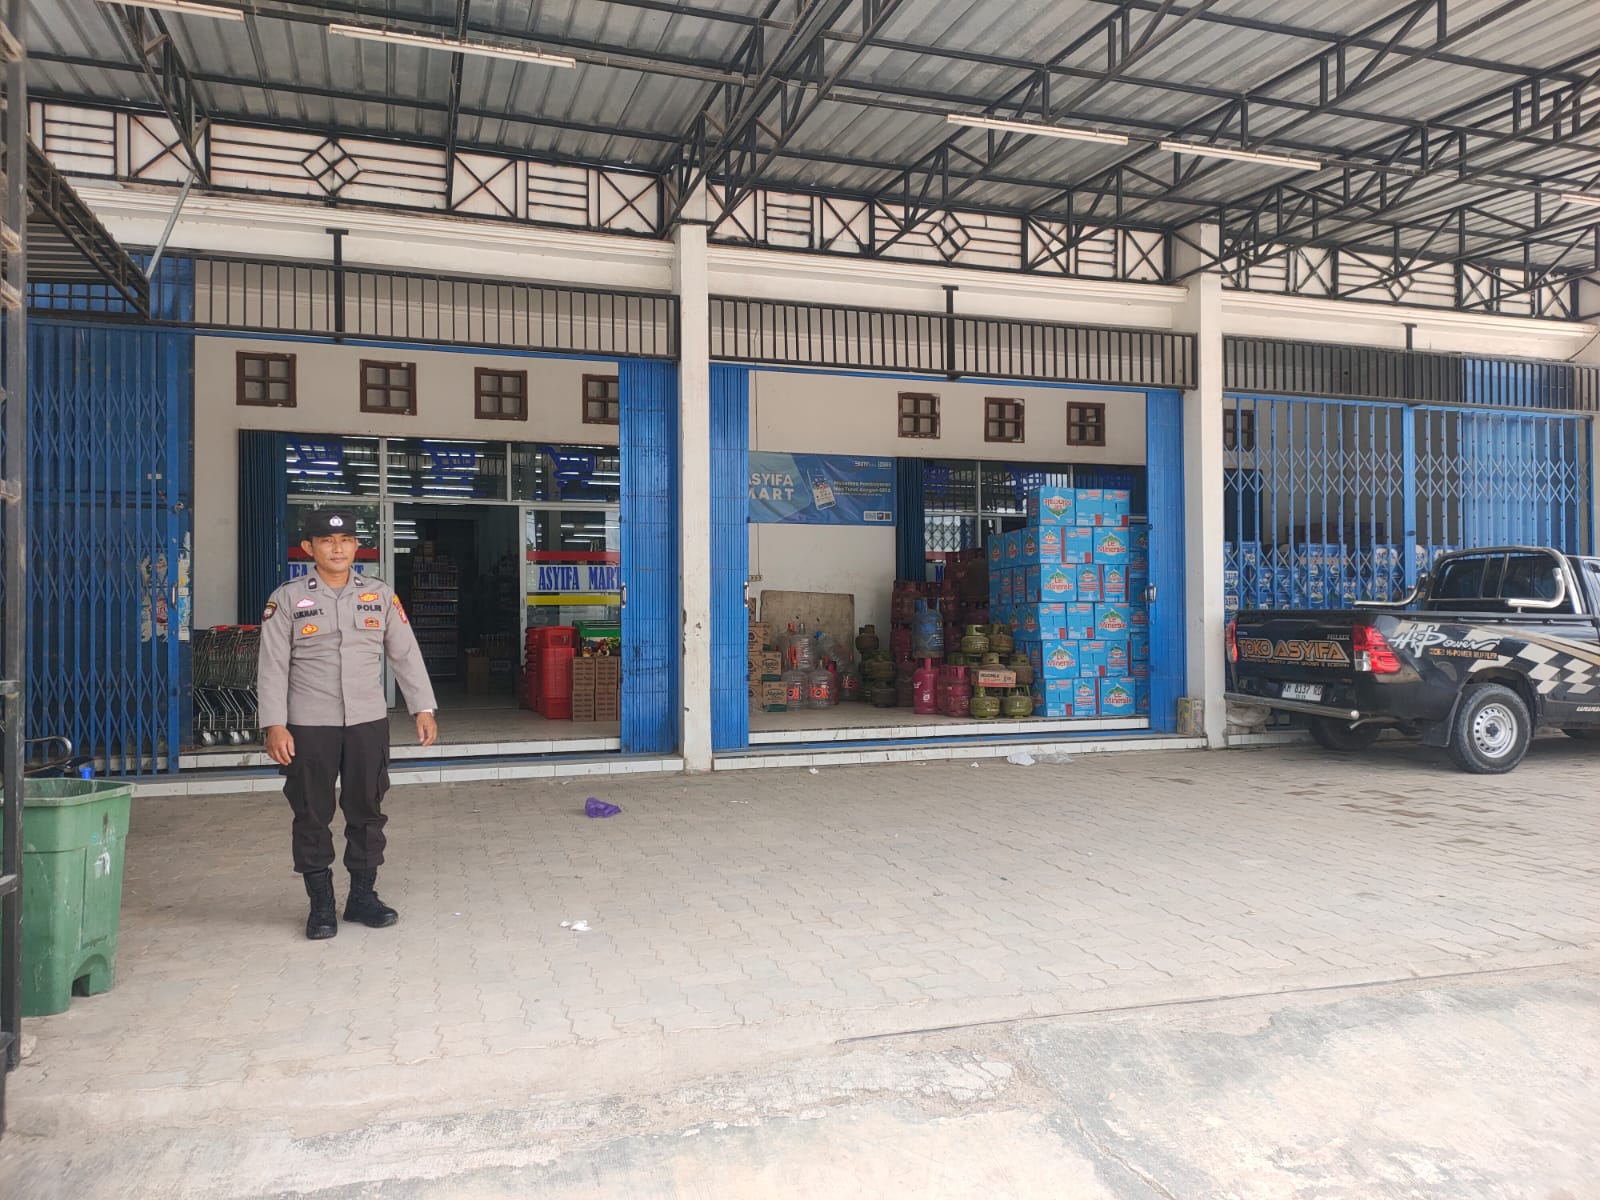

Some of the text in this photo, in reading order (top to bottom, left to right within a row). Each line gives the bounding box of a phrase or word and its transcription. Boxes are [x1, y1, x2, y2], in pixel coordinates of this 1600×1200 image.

[749, 472, 793, 486] SYIFA
[1097, 545, 1126, 553] Minerale
[538, 566, 621, 590] ASYIFA MART
[1044, 582, 1073, 590] Minerale
[356, 604, 382, 612] POLRI
[1098, 621, 1127, 629] Minerale
[1239, 639, 1348, 662] TOKO ASYIFA
[1047, 659, 1075, 667] Minerale
[1104, 696, 1132, 705] Minerale
